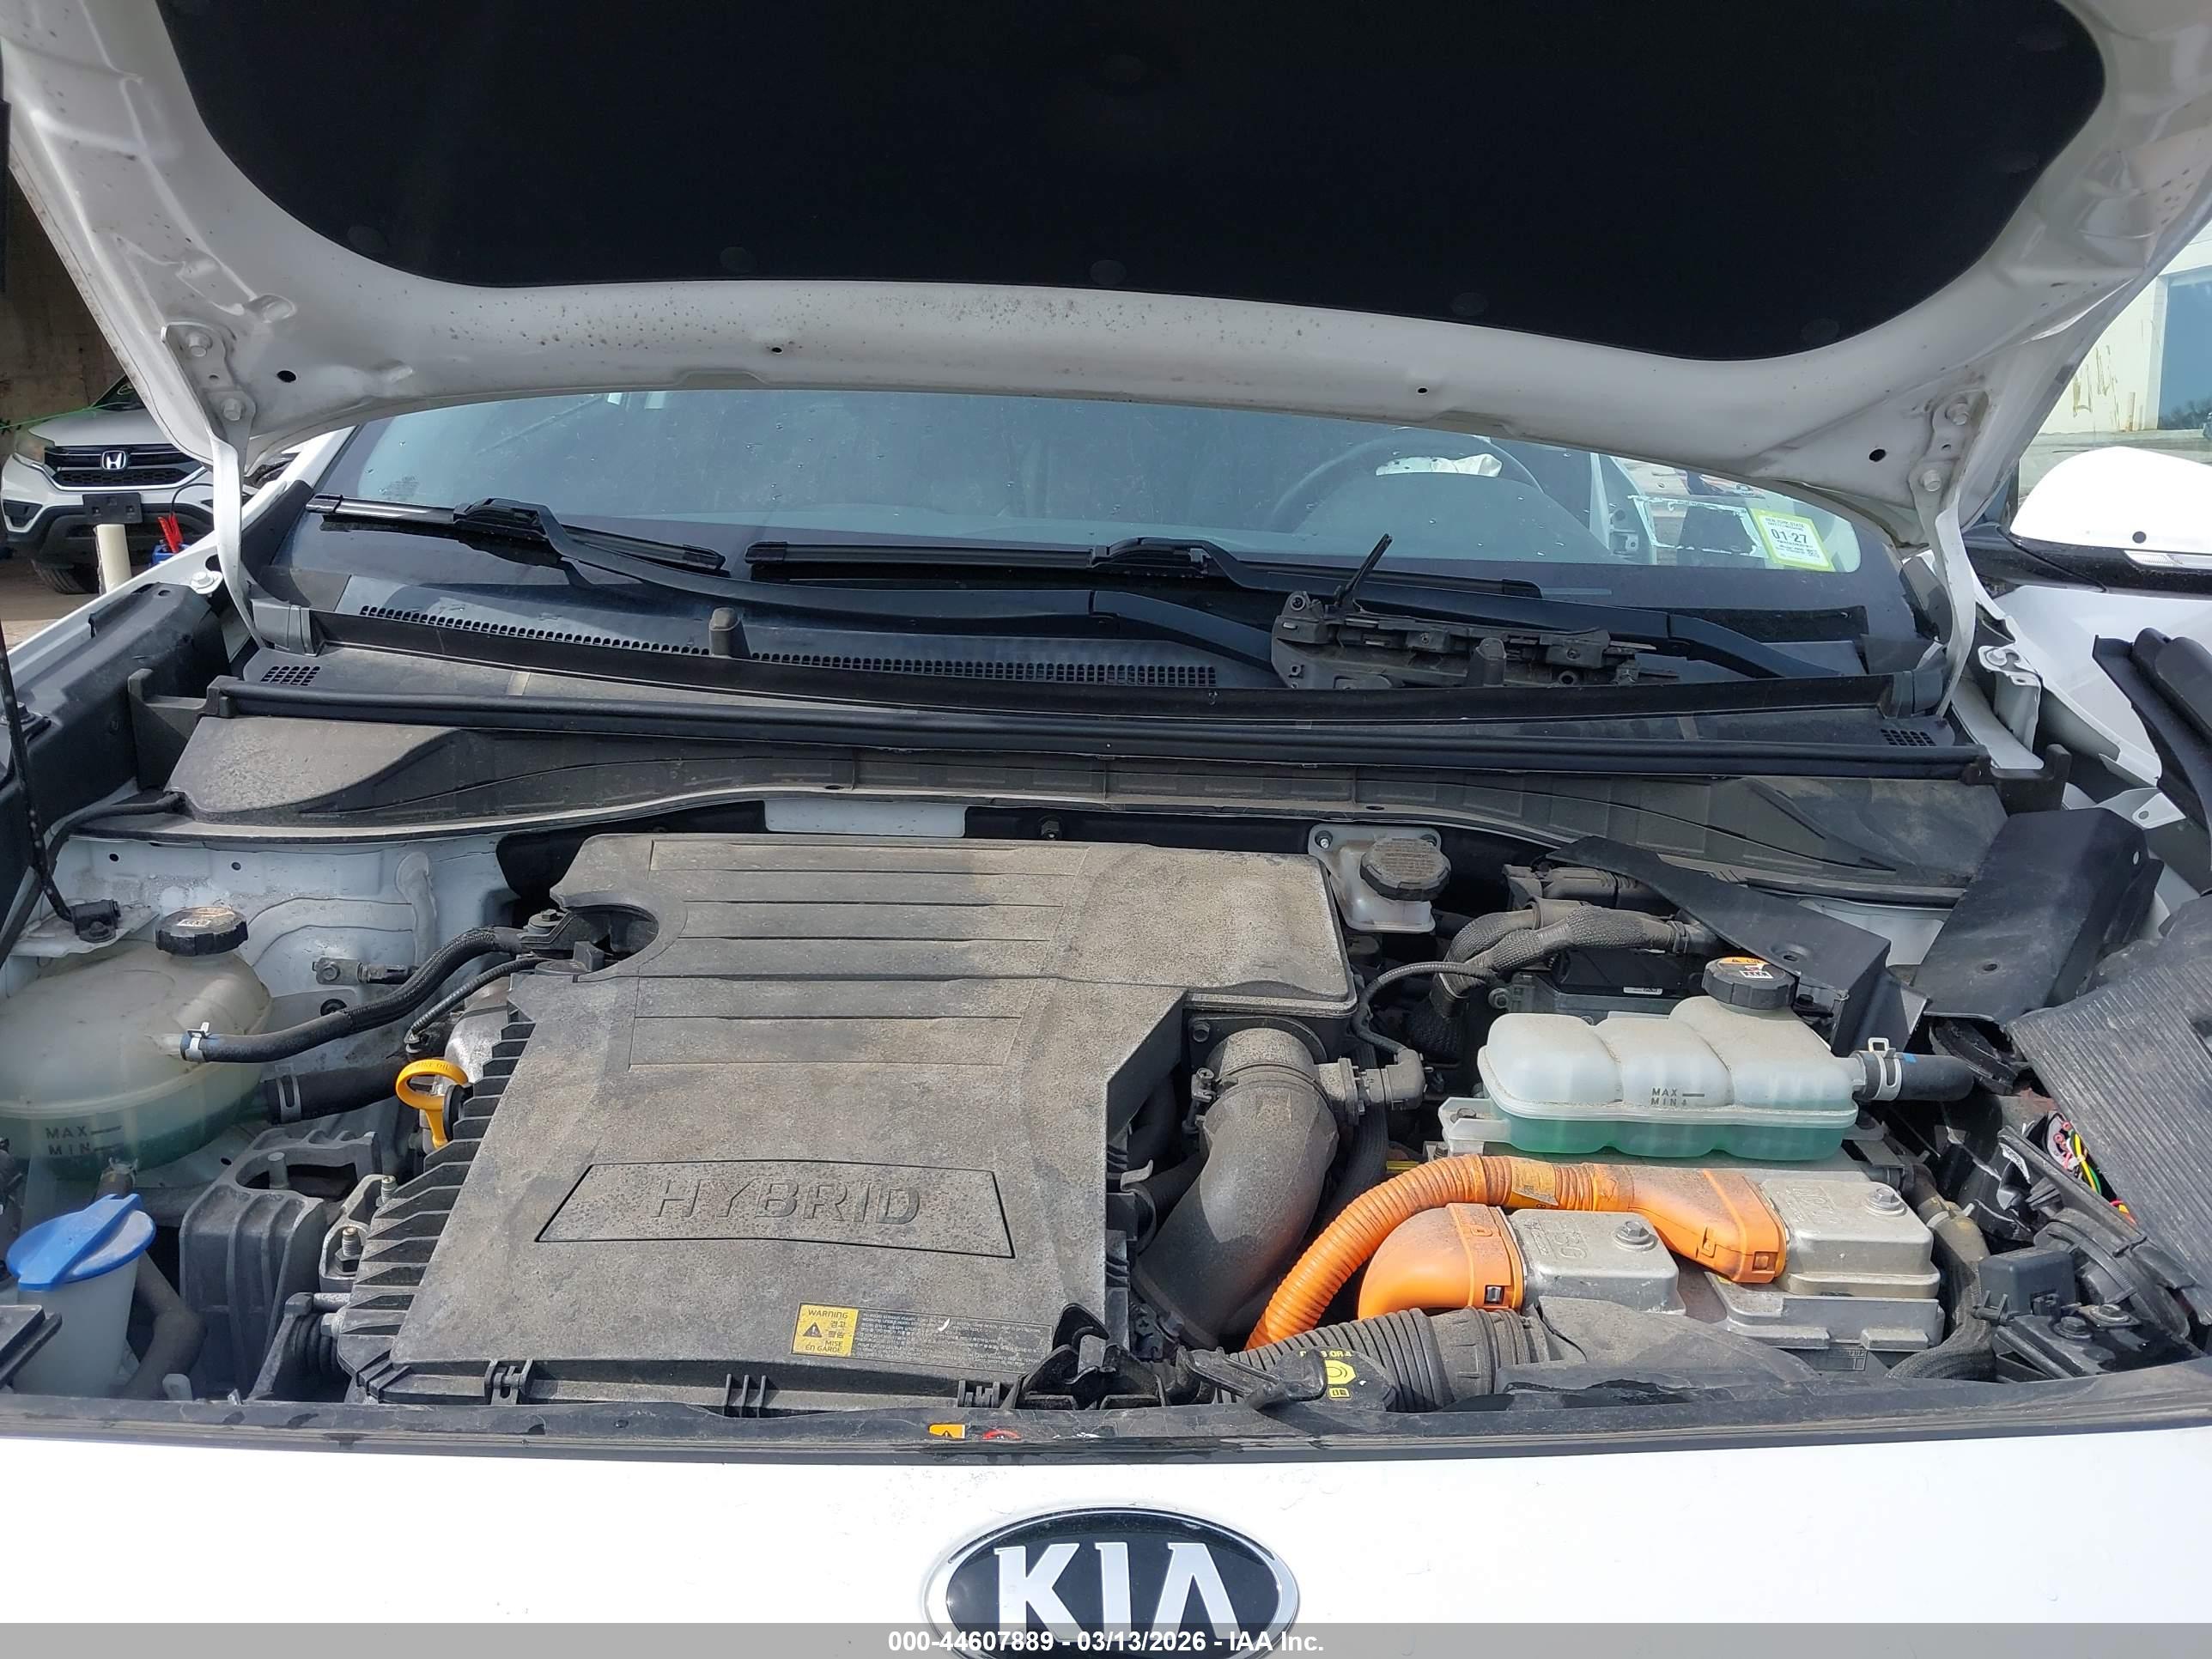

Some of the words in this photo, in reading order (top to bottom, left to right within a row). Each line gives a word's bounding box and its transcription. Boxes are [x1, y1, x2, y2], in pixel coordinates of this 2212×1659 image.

[1771, 528, 1808, 544] 01-27
[1651, 1087, 1677, 1097] MAX
[1650, 1097, 1677, 1106] MIN
[46, 1126, 88, 1139] MAX
[48, 1141, 90, 1155] MIN
[651, 1177, 921, 1225] HYBRID
[808, 1309, 849, 1319] WARNING
[993, 1541, 1242, 1643] KIA
